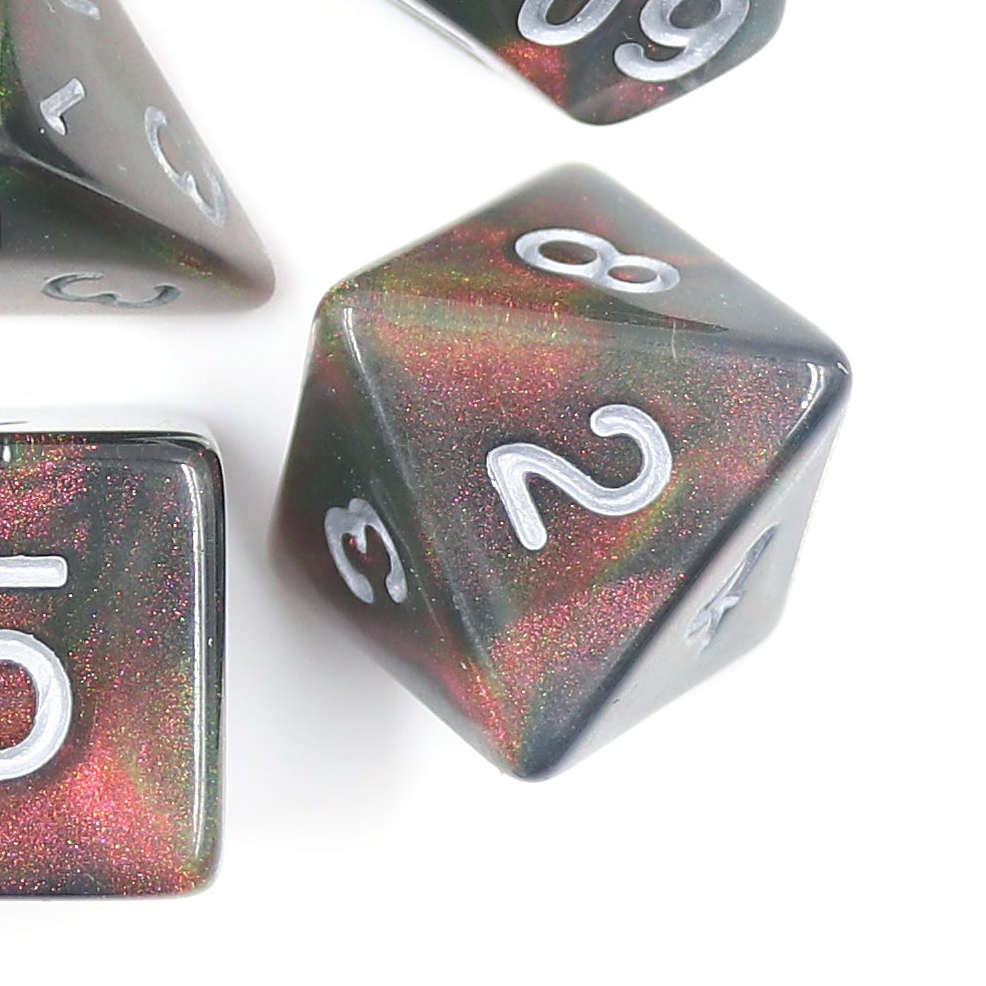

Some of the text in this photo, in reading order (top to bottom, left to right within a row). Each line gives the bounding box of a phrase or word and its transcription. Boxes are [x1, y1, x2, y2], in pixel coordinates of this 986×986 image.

[39, 76, 87, 136] 1
[144, 106, 228, 227] 3
[41, 272, 182, 309] 3
[515, 227, 680, 294] 8
[486, 404, 673, 552] 2
[323, 497, 409, 604] 3
